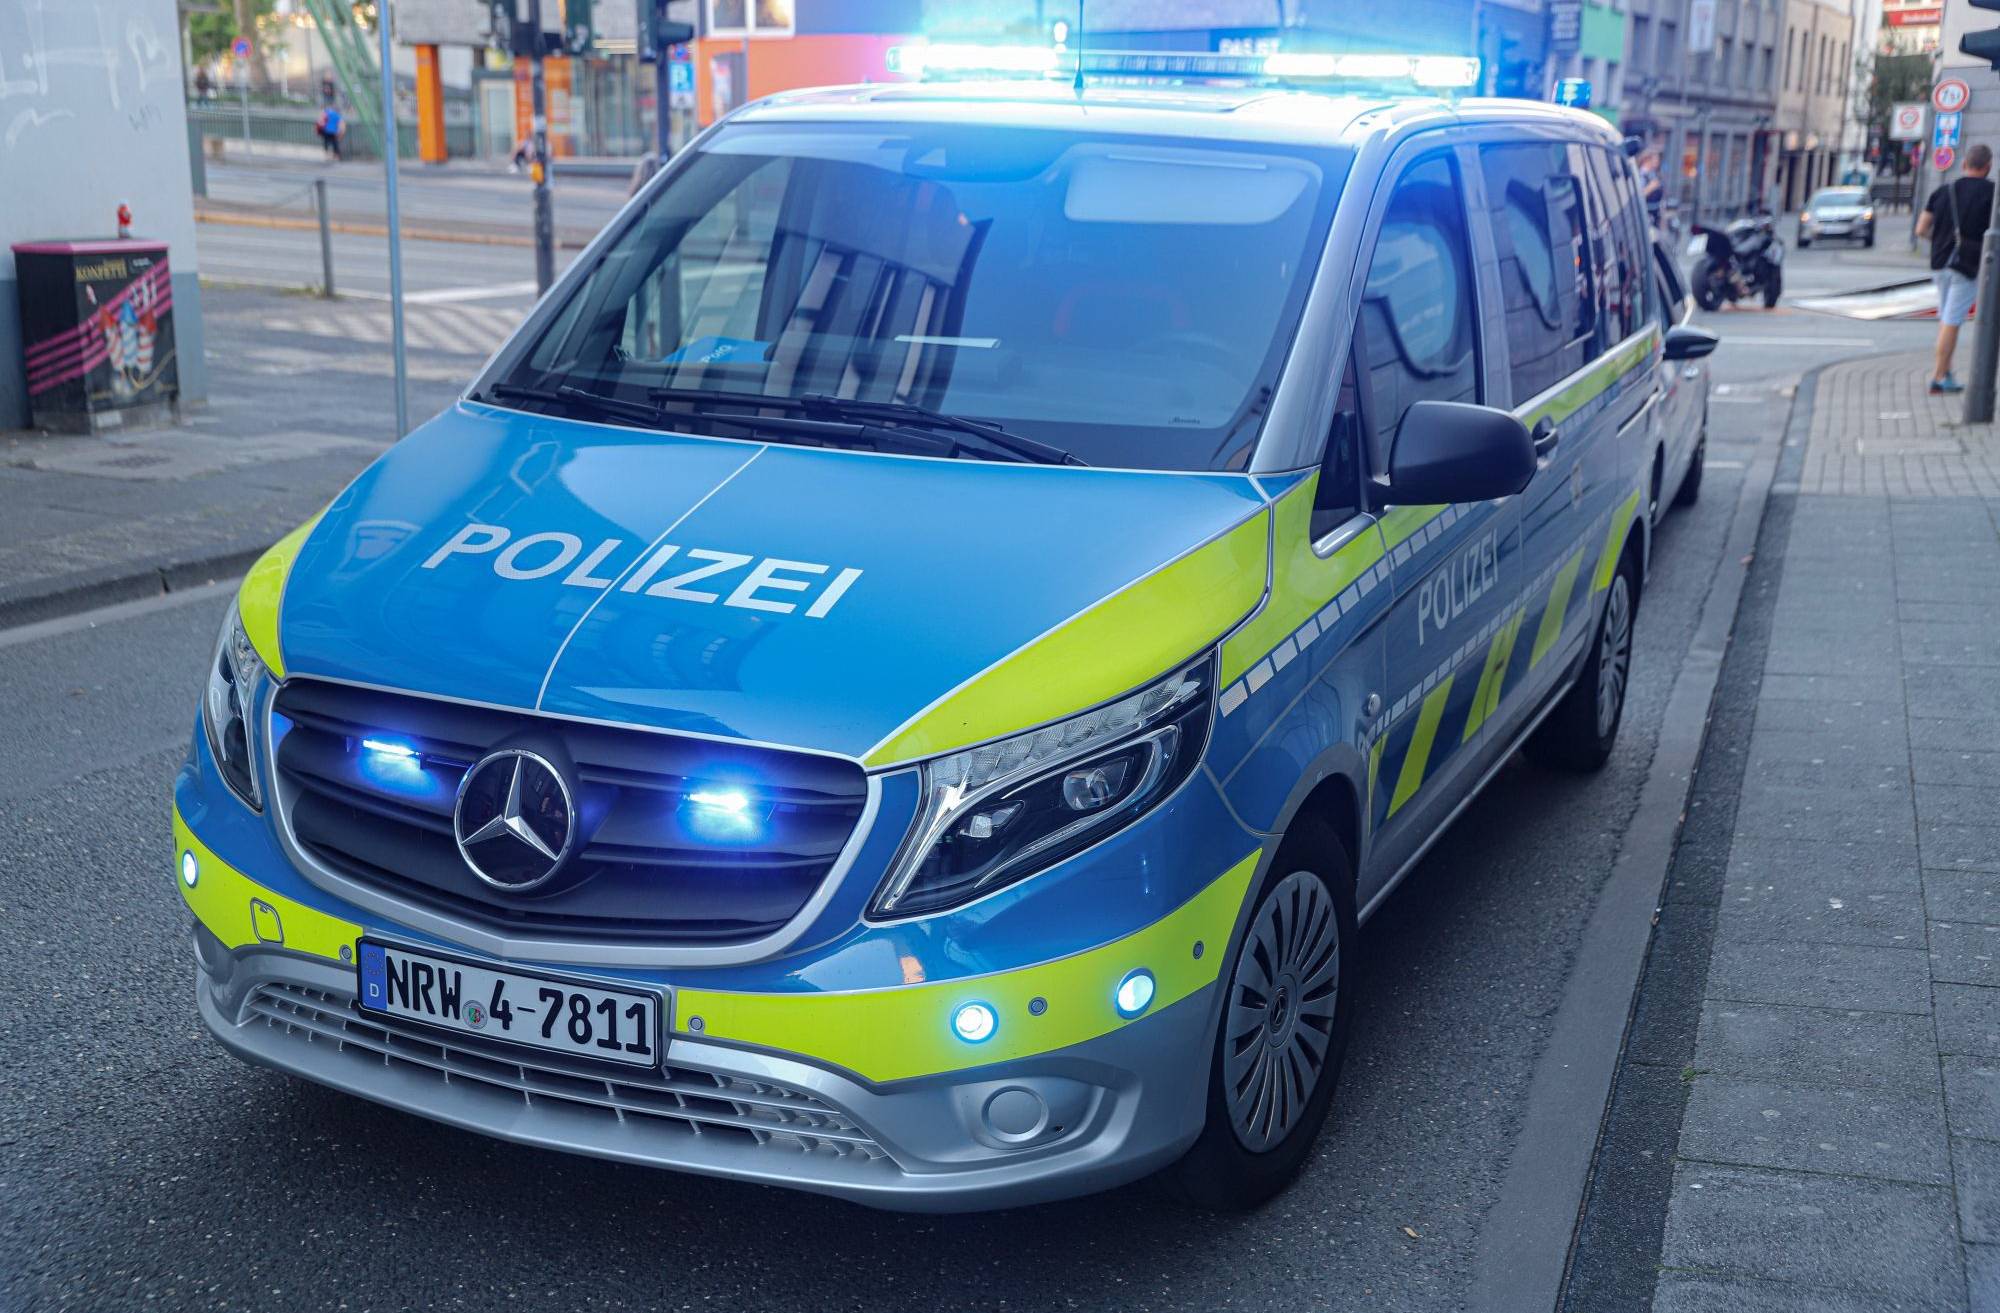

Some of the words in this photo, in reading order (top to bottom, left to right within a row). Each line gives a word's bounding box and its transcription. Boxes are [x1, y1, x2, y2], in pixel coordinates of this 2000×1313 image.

[421, 523, 864, 618] POLIZEI
[1418, 527, 1498, 647] POLIZEI
[370, 983, 380, 998] D
[385, 955, 462, 1020] NRW
[489, 979, 651, 1055] 4-7811
